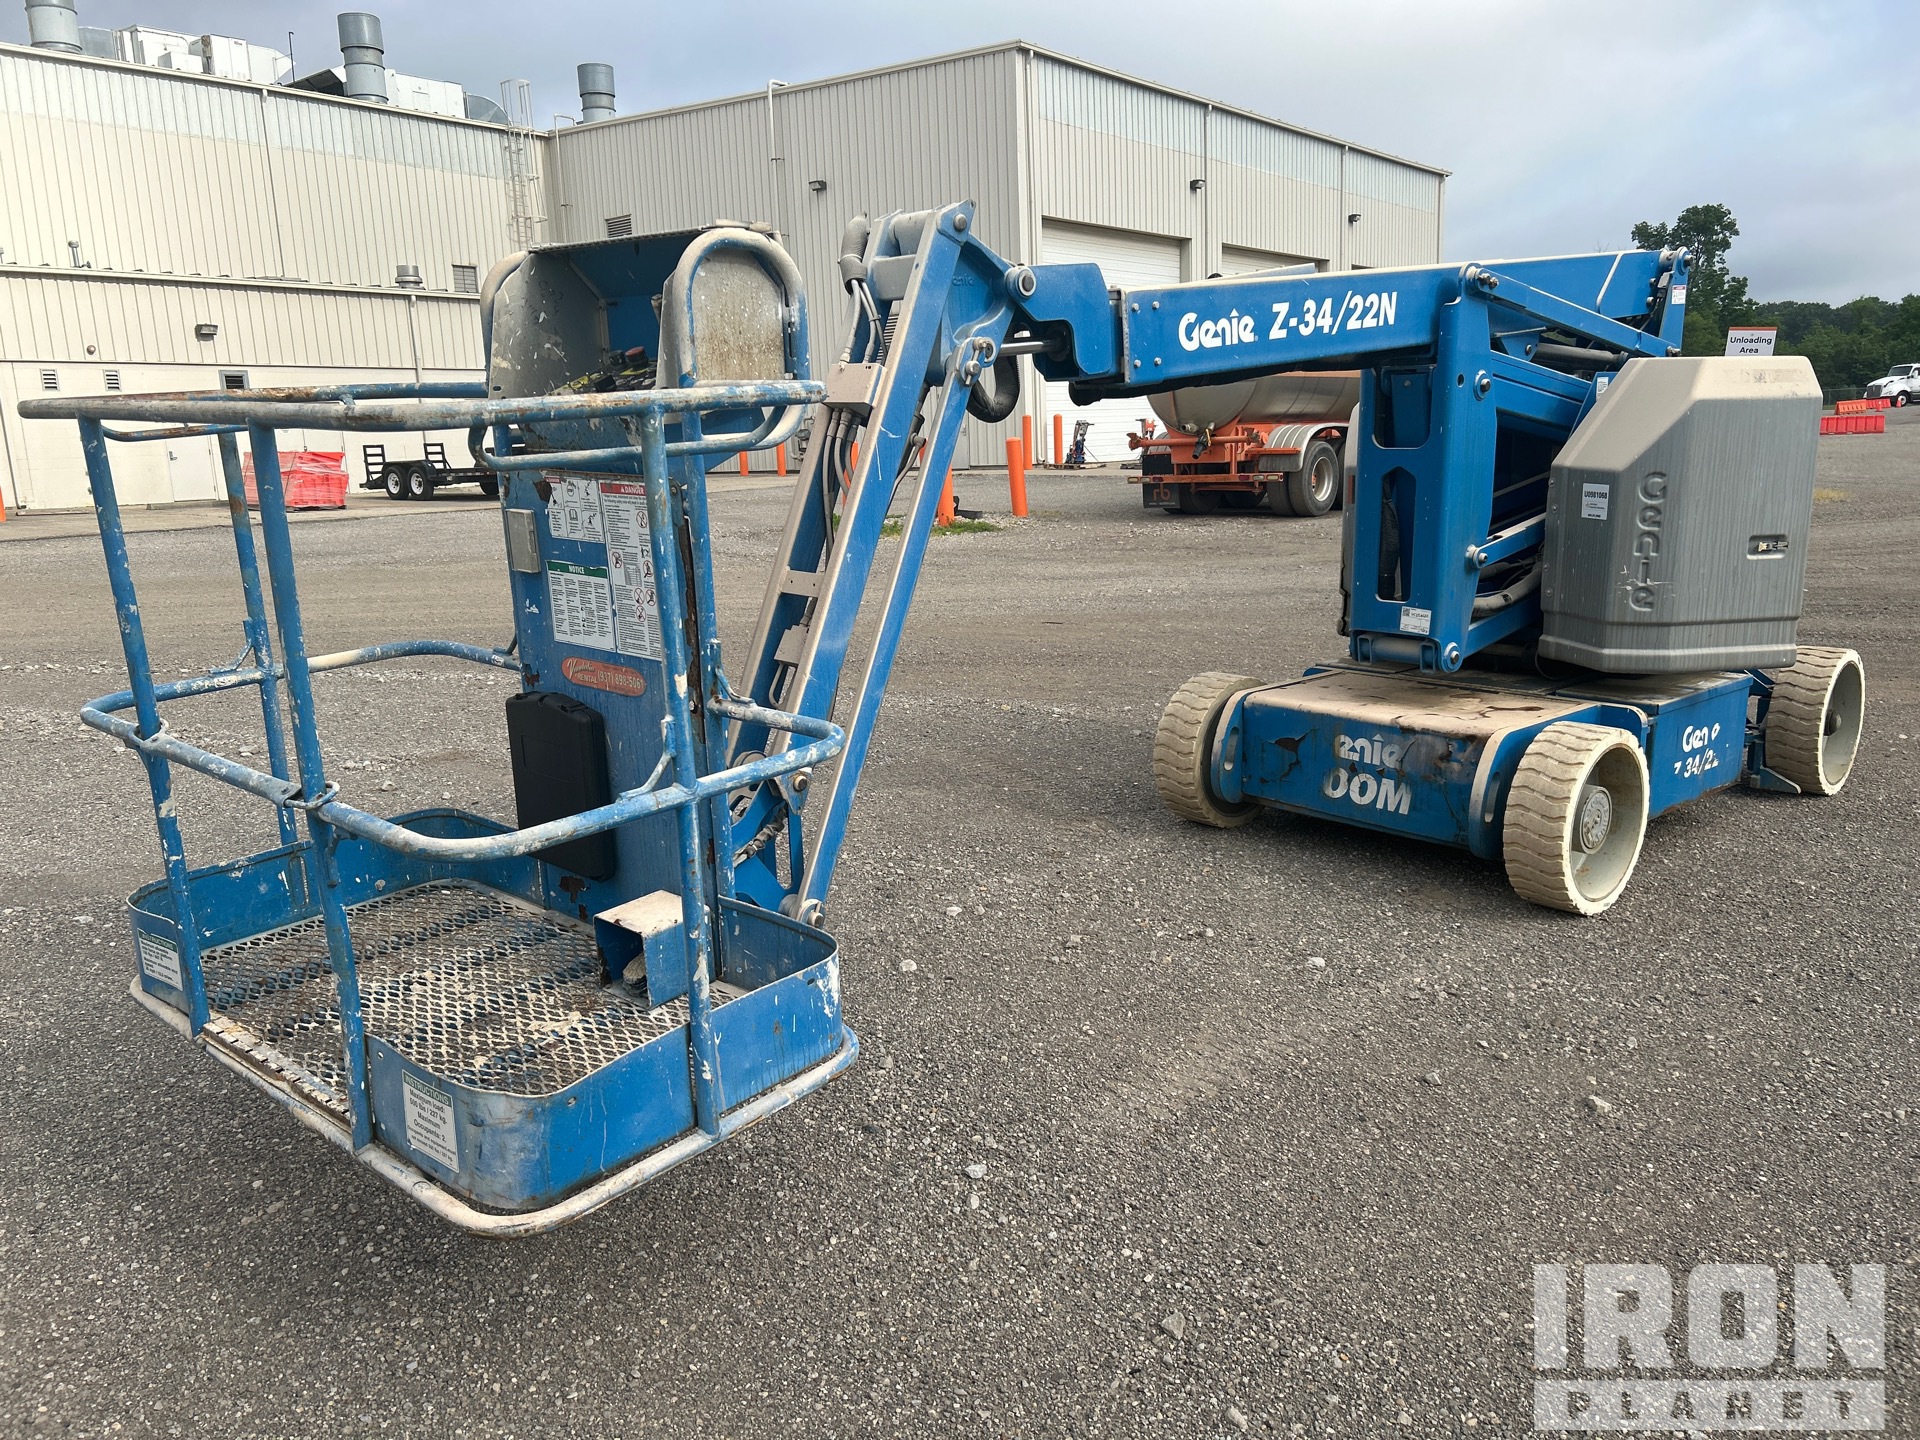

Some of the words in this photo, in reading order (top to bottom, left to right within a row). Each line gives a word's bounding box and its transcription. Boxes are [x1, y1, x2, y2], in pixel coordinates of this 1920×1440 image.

[1178, 308, 1256, 352] Genie
[1268, 289, 1398, 340] Z-34/22N
[1730, 336, 1772, 345] Unloading
[624, 486, 645, 494] DANGER
[568, 565, 585, 574] NOTICE
[597, 670, 614, 684] (937)
[405, 1074, 449, 1105] INSTRUCTIONS
[409, 1088, 433, 1107] Maximum
[417, 1111, 441, 1130] Maximum
[429, 1108, 438, 1119] 227
